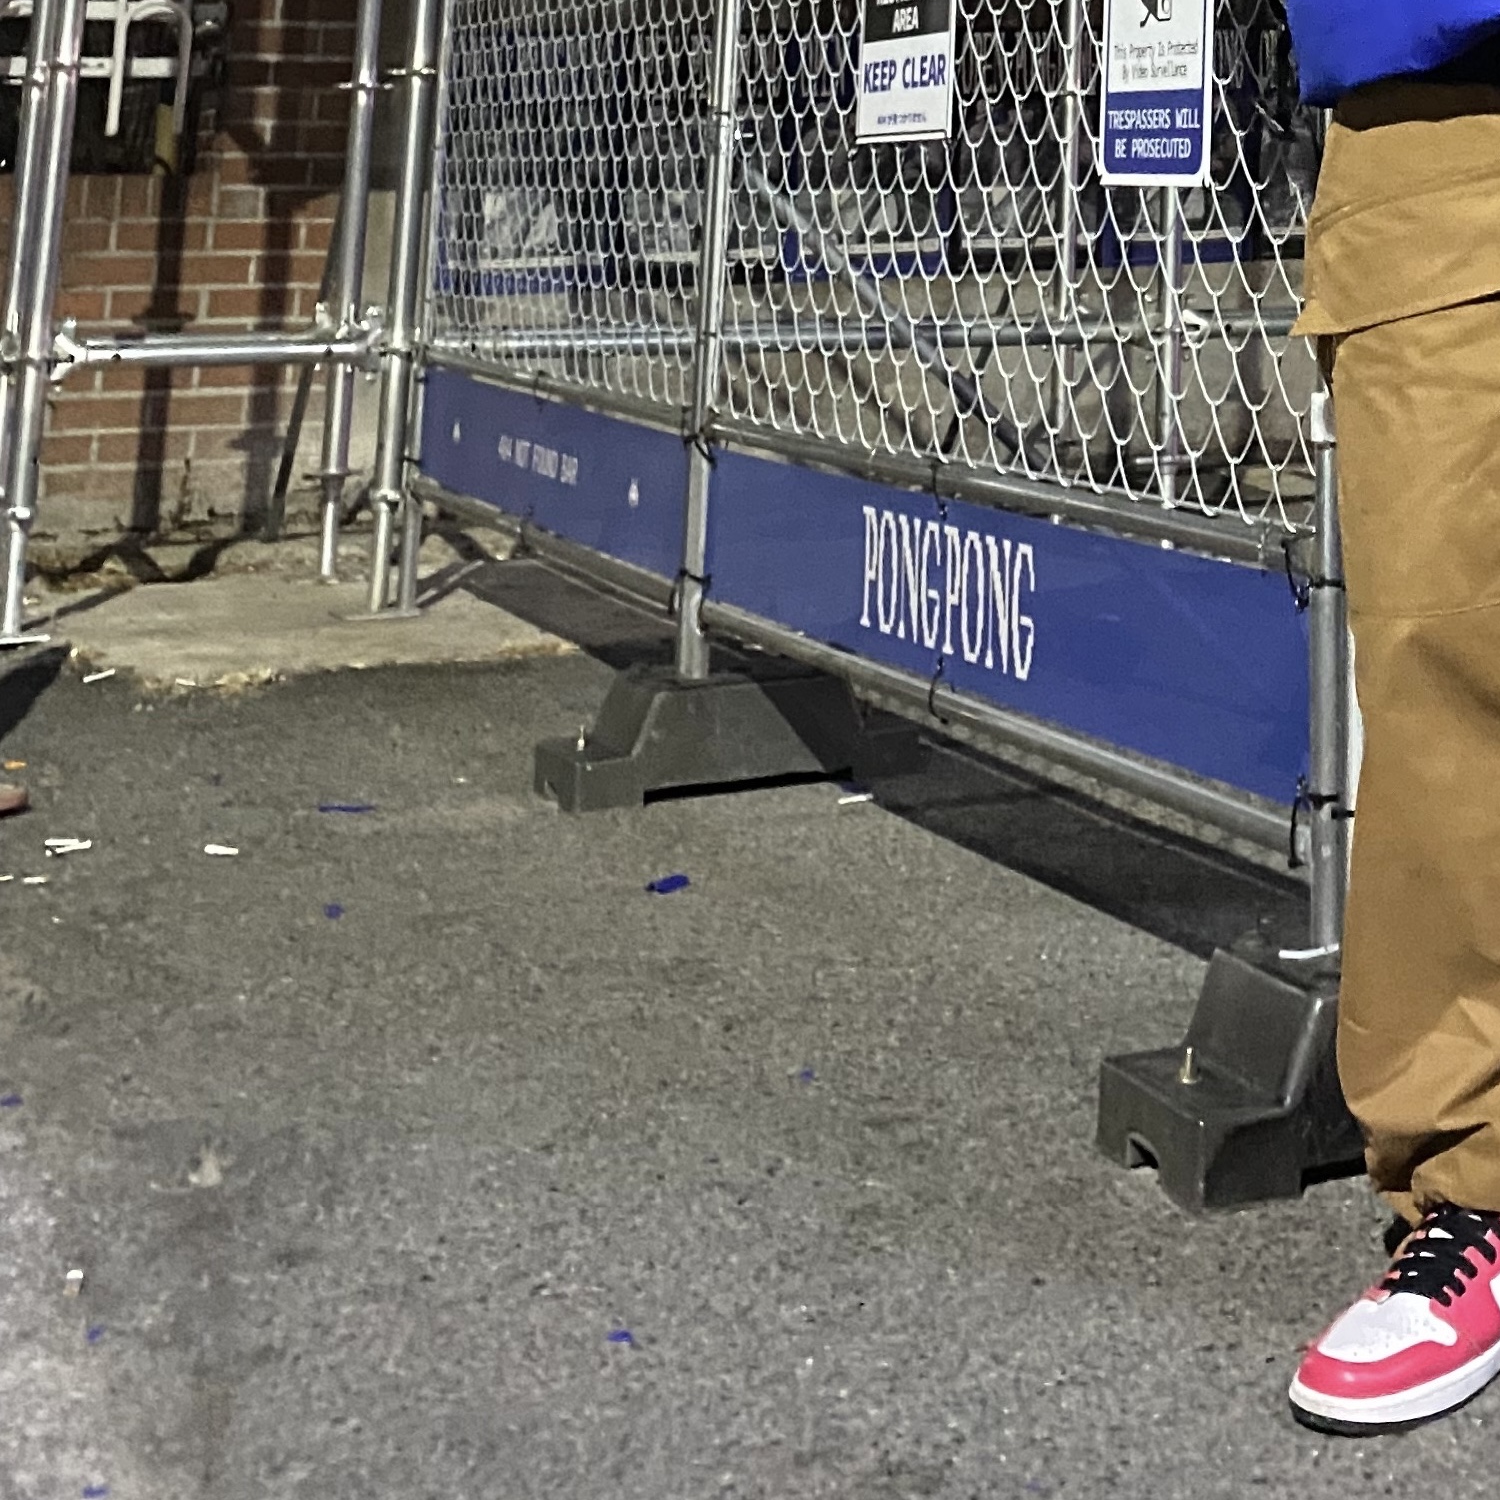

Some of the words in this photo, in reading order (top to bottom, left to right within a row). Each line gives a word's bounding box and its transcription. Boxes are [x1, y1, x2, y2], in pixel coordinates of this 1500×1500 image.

[892, 6, 919, 33] AREA
[863, 59, 897, 94] KEEP
[902, 54, 946, 89] CLEAR
[1107, 108, 1171, 130] TRESPASSERS
[1175, 108, 1200, 128] WILL
[1114, 138, 1127, 158] BE
[1131, 138, 1191, 159] PROSECUTED
[860, 505, 1036, 681] PONGPONG
